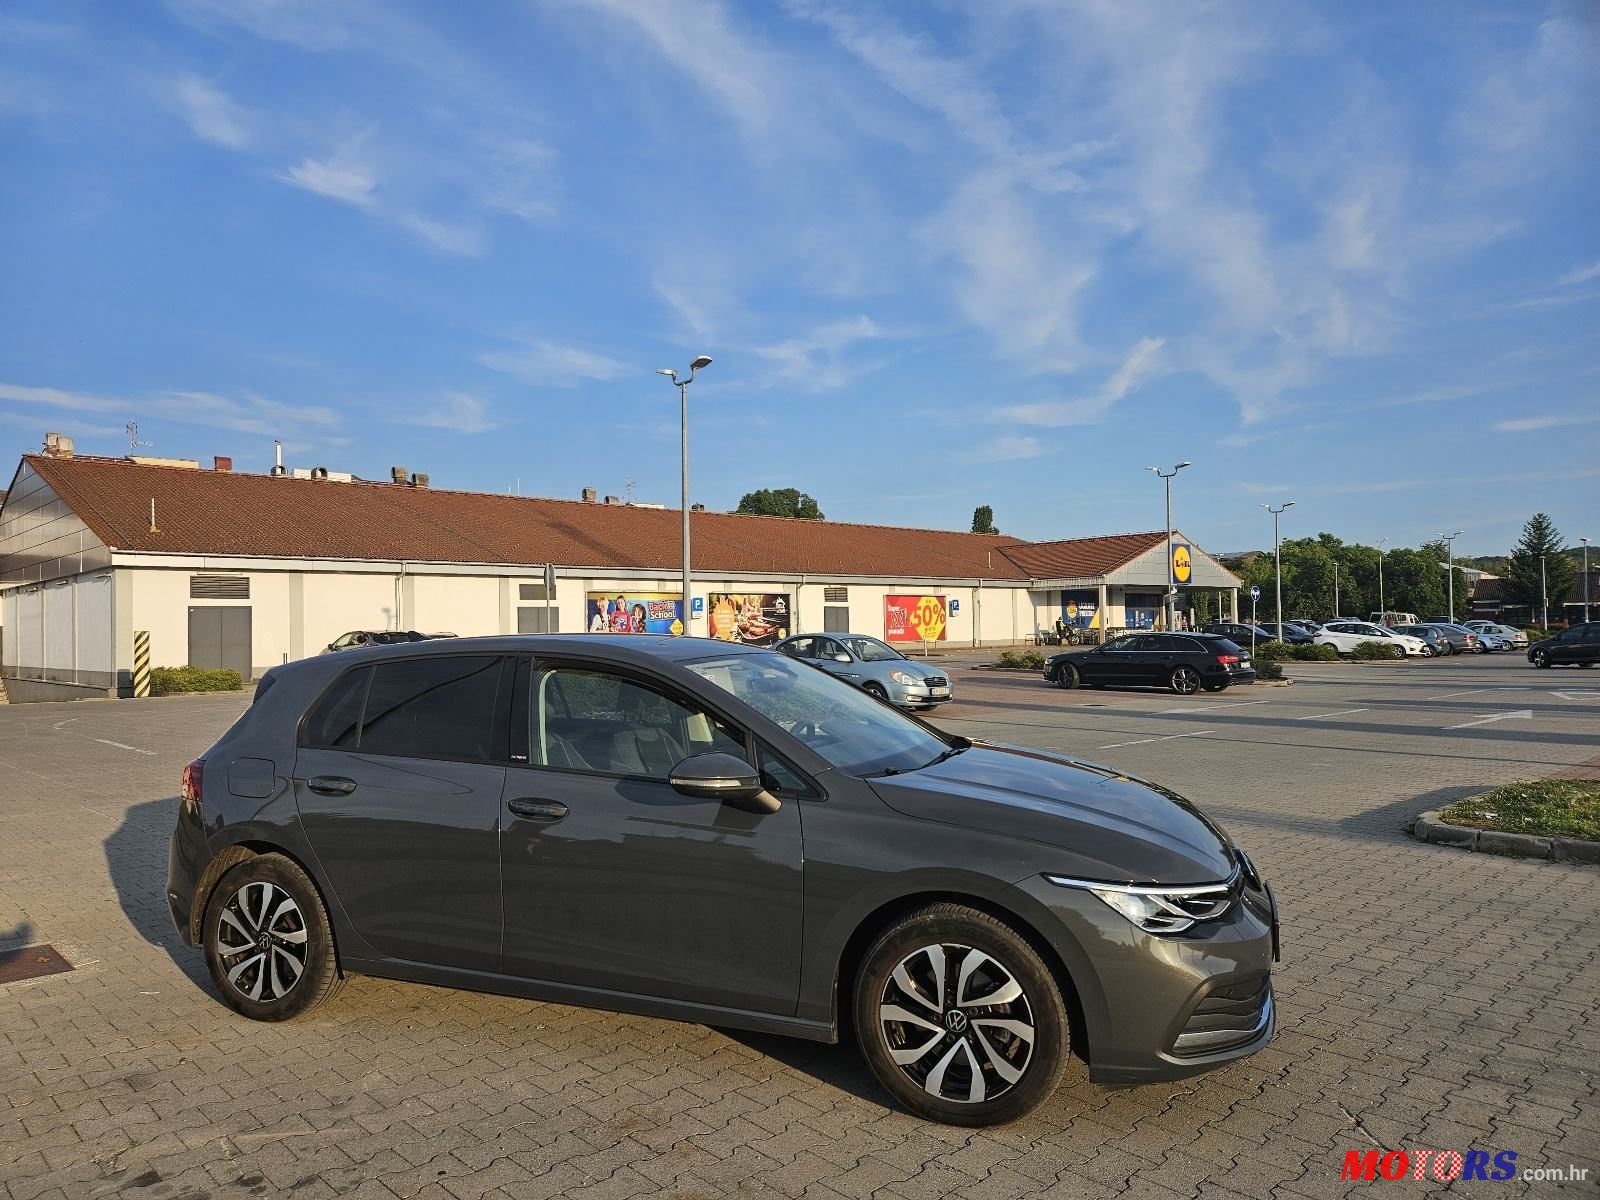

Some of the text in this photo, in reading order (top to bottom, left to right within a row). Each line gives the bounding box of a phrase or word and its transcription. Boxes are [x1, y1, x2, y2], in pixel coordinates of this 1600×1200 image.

[695, 600, 701, 609] P
[650, 610, 676, 620] School
[912, 604, 945, 628] 50%
